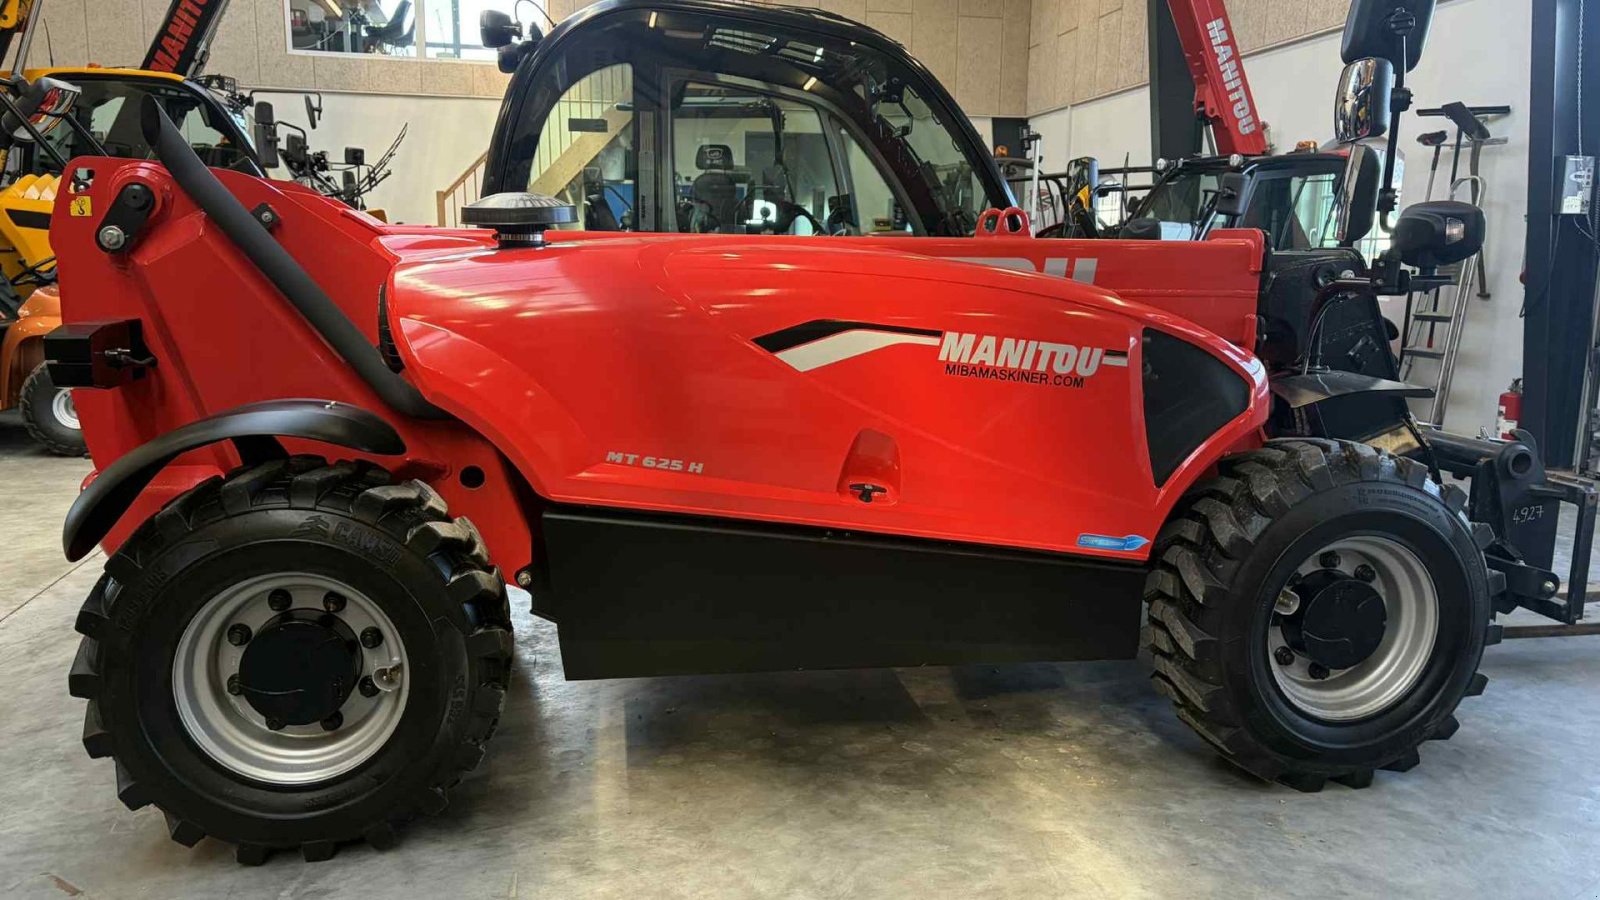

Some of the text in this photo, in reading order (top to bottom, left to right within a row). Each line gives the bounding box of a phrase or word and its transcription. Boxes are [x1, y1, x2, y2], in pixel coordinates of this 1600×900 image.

[149, 0, 208, 72] MANIT
[1206, 18, 1256, 135] MANITOU
[938, 331, 1103, 377] MANITOU
[945, 364, 1085, 388] MIBAMASKINER.COM
[606, 451, 704, 474] MT 625 H
[1512, 505, 1544, 525] 4927
